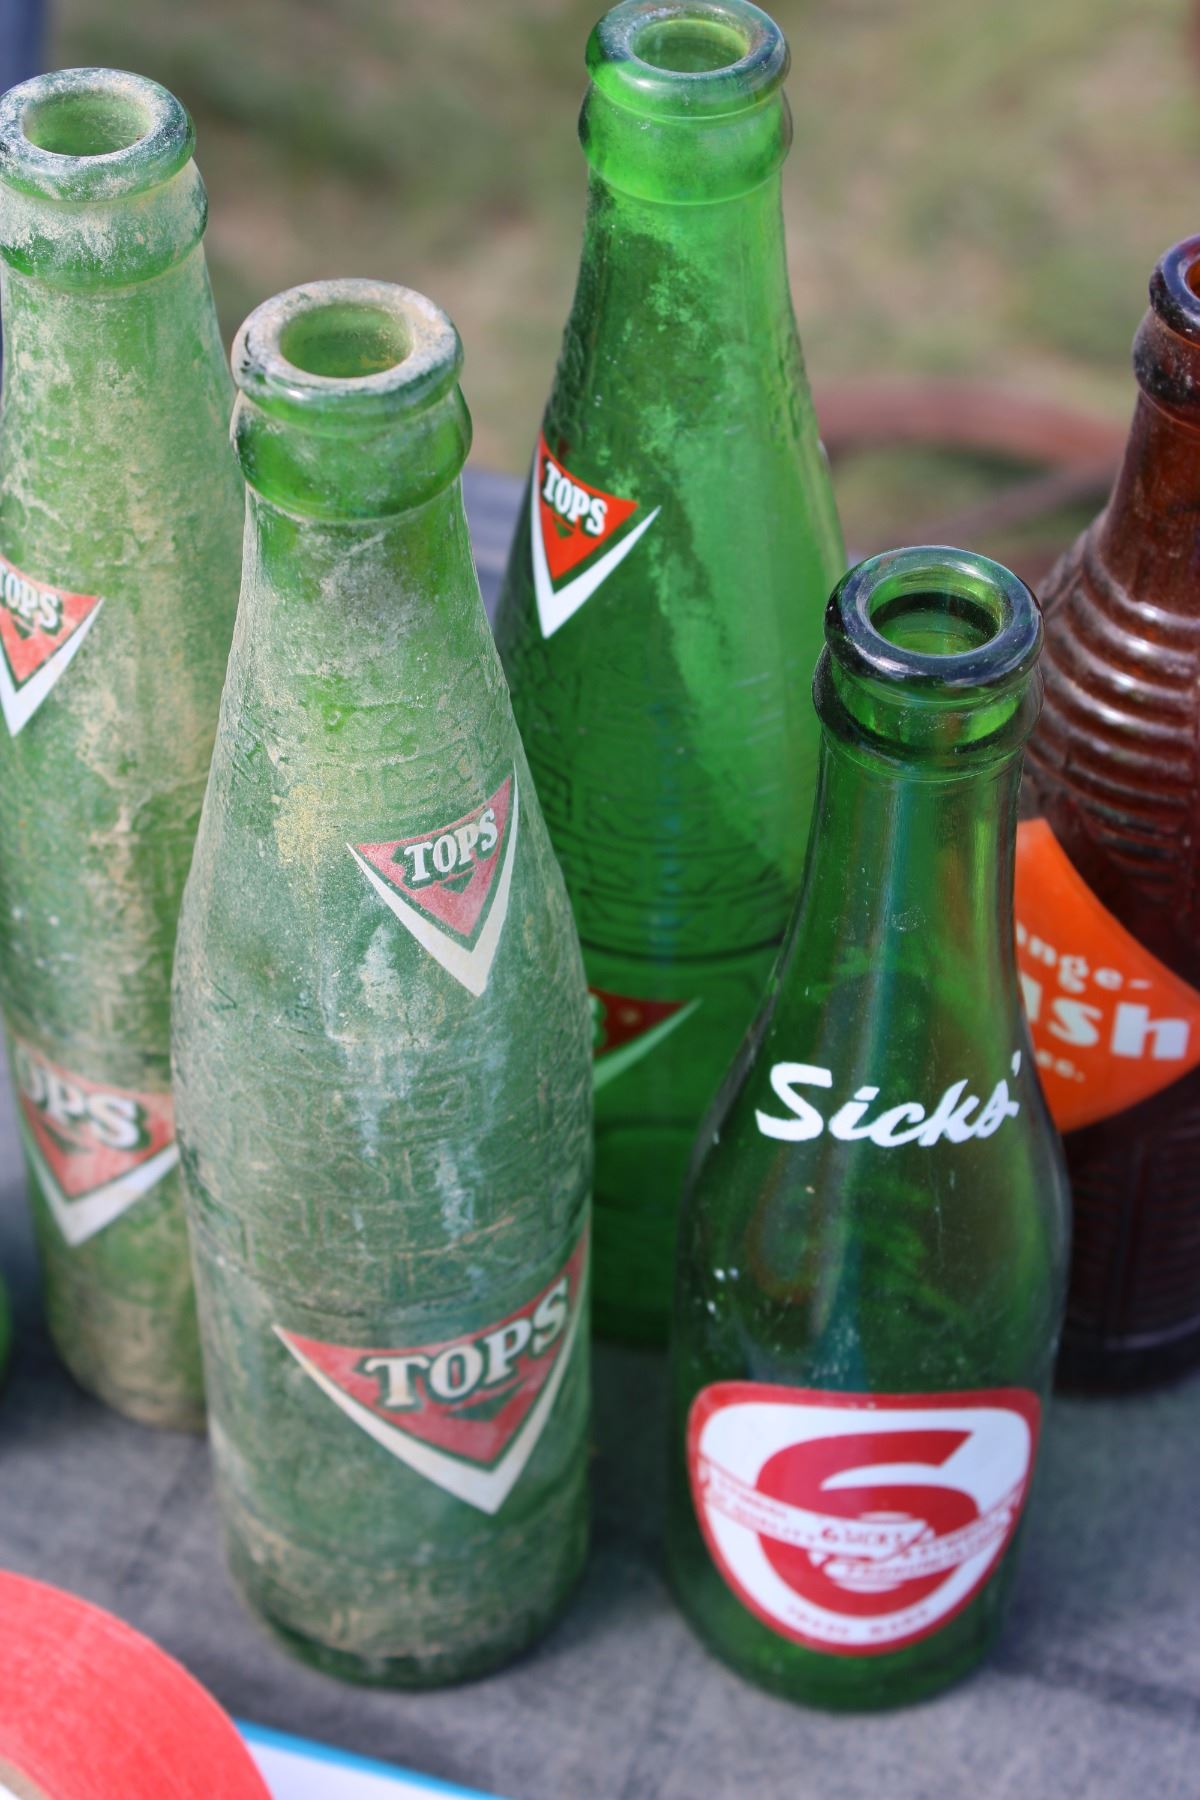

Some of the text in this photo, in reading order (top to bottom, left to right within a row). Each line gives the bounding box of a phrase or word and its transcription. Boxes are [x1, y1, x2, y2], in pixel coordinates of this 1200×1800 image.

[543, 461, 608, 536] TOPS
[404, 807, 498, 882] TOPS
[16, 1046, 140, 1148] OPS
[755, 1050, 1021, 1147] Sicks'
[364, 1278, 568, 1407] TOPS
